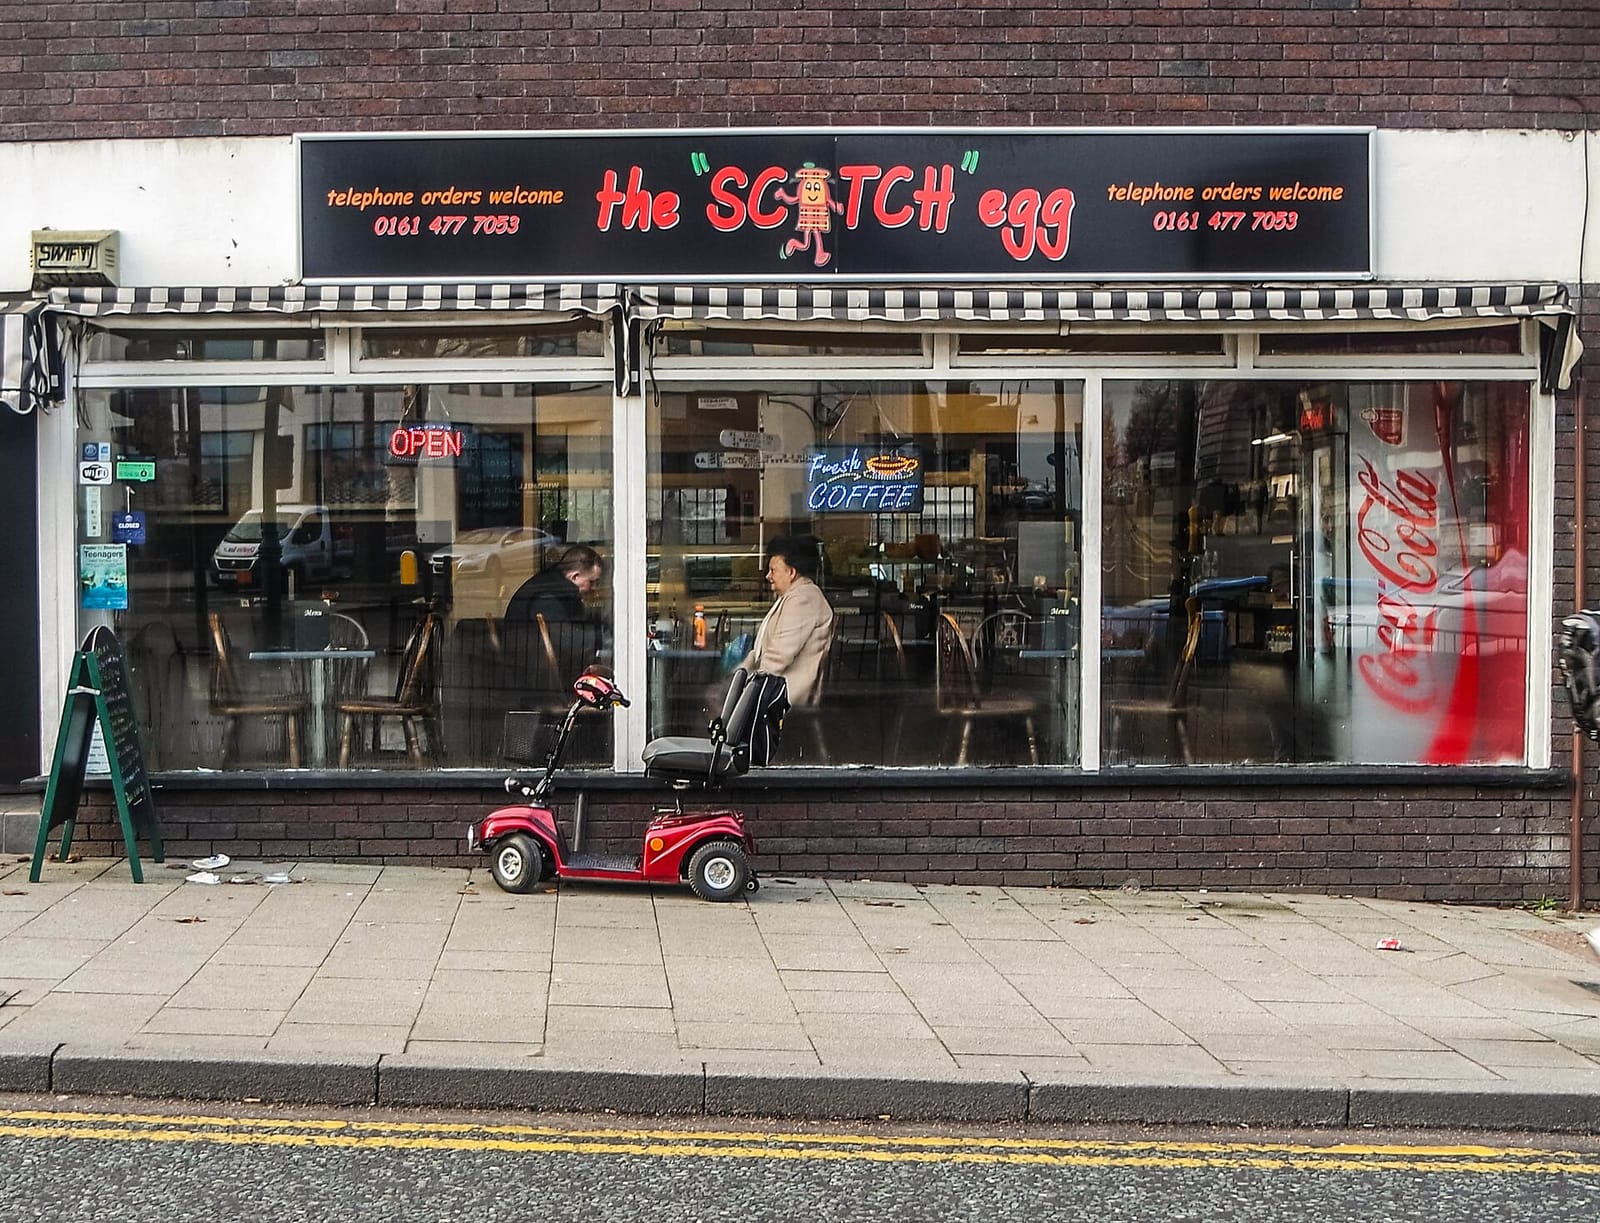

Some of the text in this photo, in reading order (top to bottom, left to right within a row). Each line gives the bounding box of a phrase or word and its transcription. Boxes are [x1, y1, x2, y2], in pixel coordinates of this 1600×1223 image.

[327, 185, 565, 211] telephone orders welcome
[1107, 181, 1345, 206] telephone orders welcome
[374, 215, 520, 236] 0161 477 7053
[596, 166, 680, 232] the
[978, 188, 1076, 262] egg
[1153, 211, 1299, 232] 0161 477 7053
[391, 429, 462, 457] OPEN
[808, 448, 861, 482] Fresh
[808, 483, 918, 510] COFFEE
[84, 550, 124, 559] Teenagers
[304, 609, 323, 617] Menu
[1050, 607, 1070, 615] Menu
